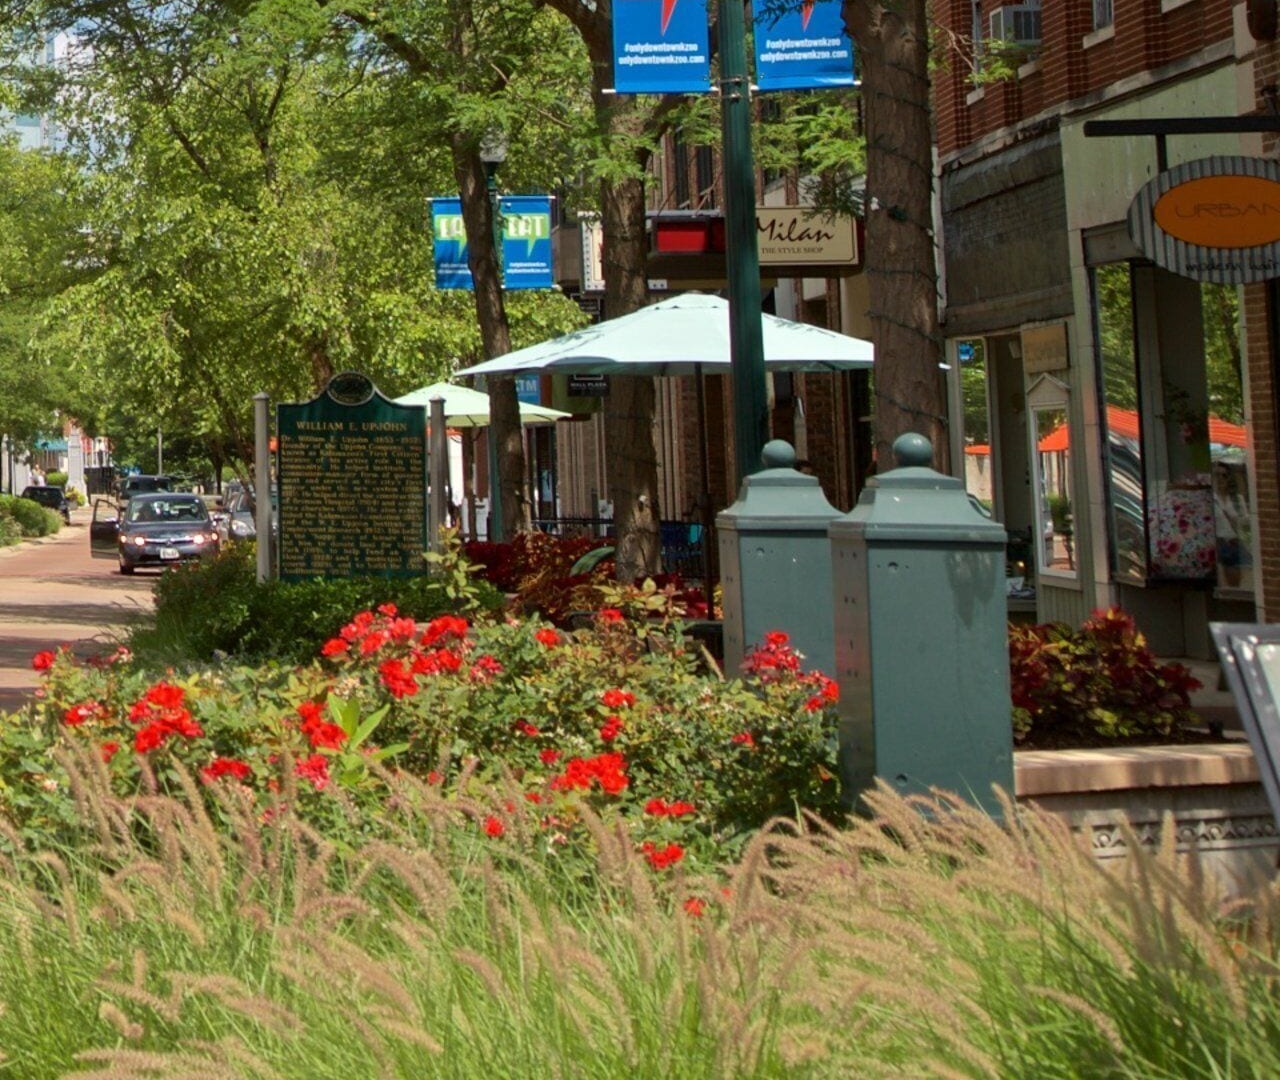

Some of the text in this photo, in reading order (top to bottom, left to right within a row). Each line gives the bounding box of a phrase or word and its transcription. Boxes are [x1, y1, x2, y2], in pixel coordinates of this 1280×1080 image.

[624, 42, 698, 53] #onlydowntownkzoo
[618, 54, 705, 66] onlydowntownkzoo.com
[760, 49, 848, 62] onlydowntownkzoo.com
[508, 215, 544, 237] EAT
[755, 217, 834, 242] Milan
[296, 422, 407, 432] WILLIAM E. UPJOHN
